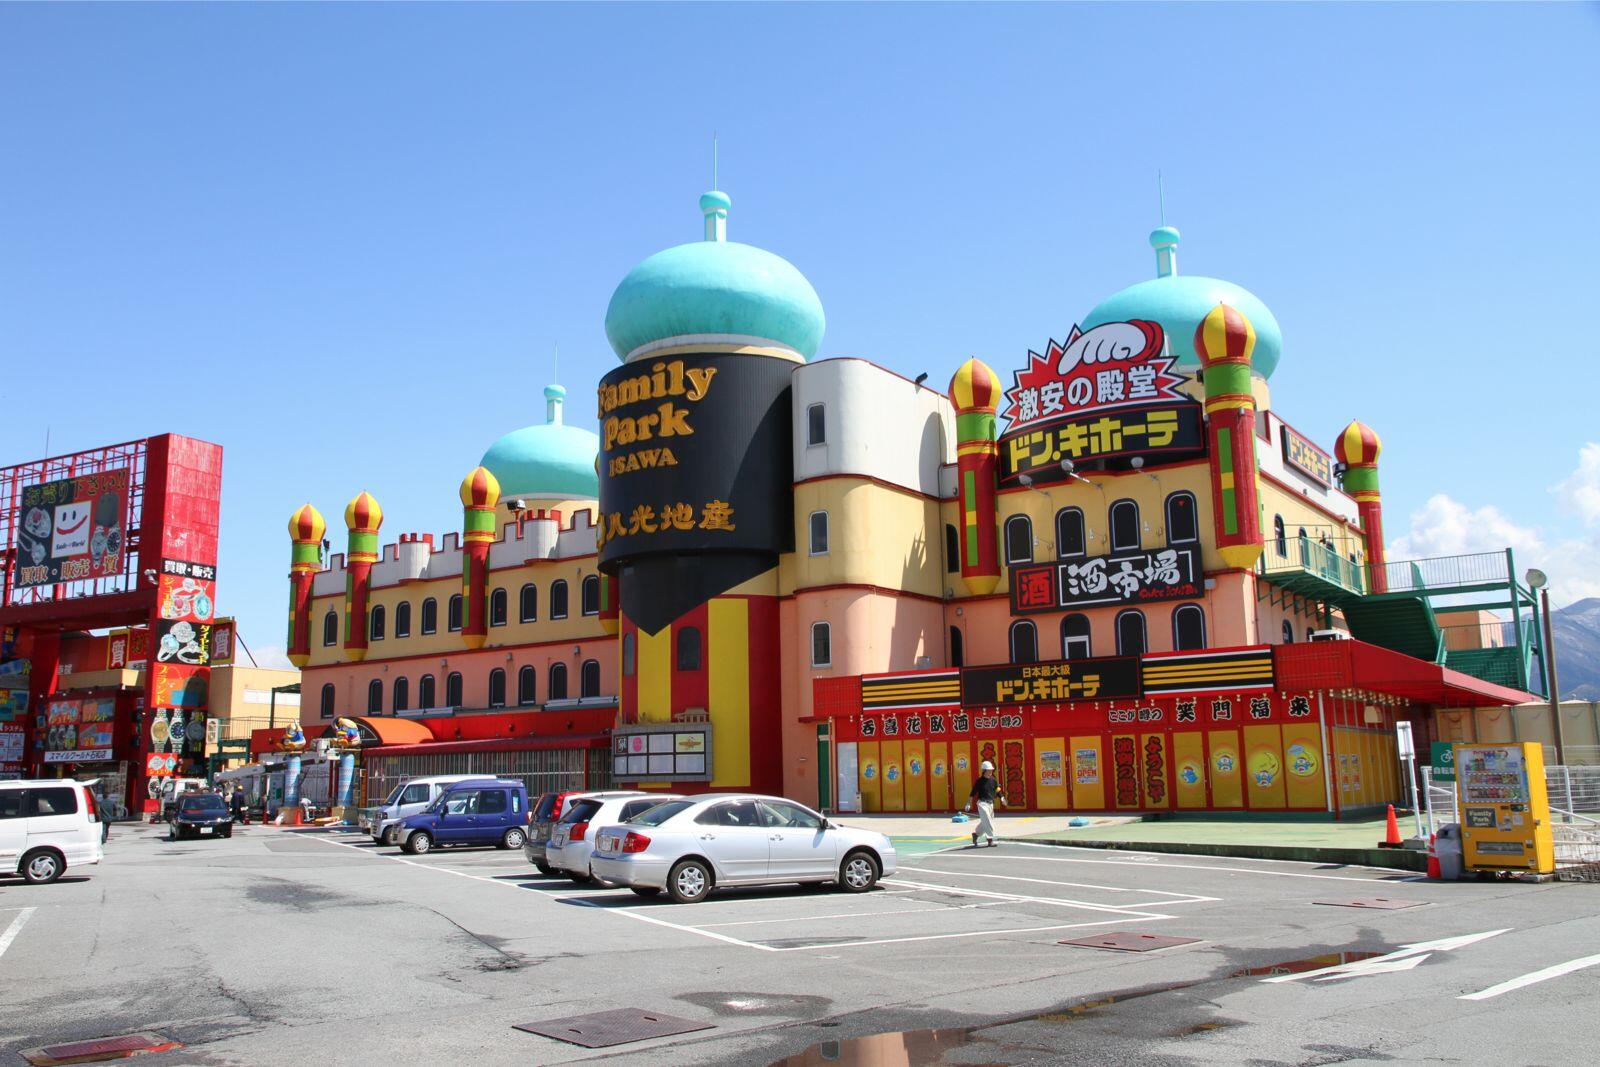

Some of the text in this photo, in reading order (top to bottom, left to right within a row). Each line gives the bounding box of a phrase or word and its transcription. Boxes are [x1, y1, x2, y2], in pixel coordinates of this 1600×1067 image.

[598, 360, 718, 419] Family
[1018, 365, 1158, 422] 激安の殿堂
[604, 401, 695, 452] Park
[609, 448, 679, 477] ISAWA
[1021, 571, 1051, 605] 酒
[1068, 549, 1181, 598] 酒市場
[214, 628, 230, 660] 質
[155, 665, 168, 705] ブランド
[1022, 665, 1071, 678] 日本最大級
[1041, 770, 1061, 778] OPEN
[1077, 768, 1097, 777] OPEN
